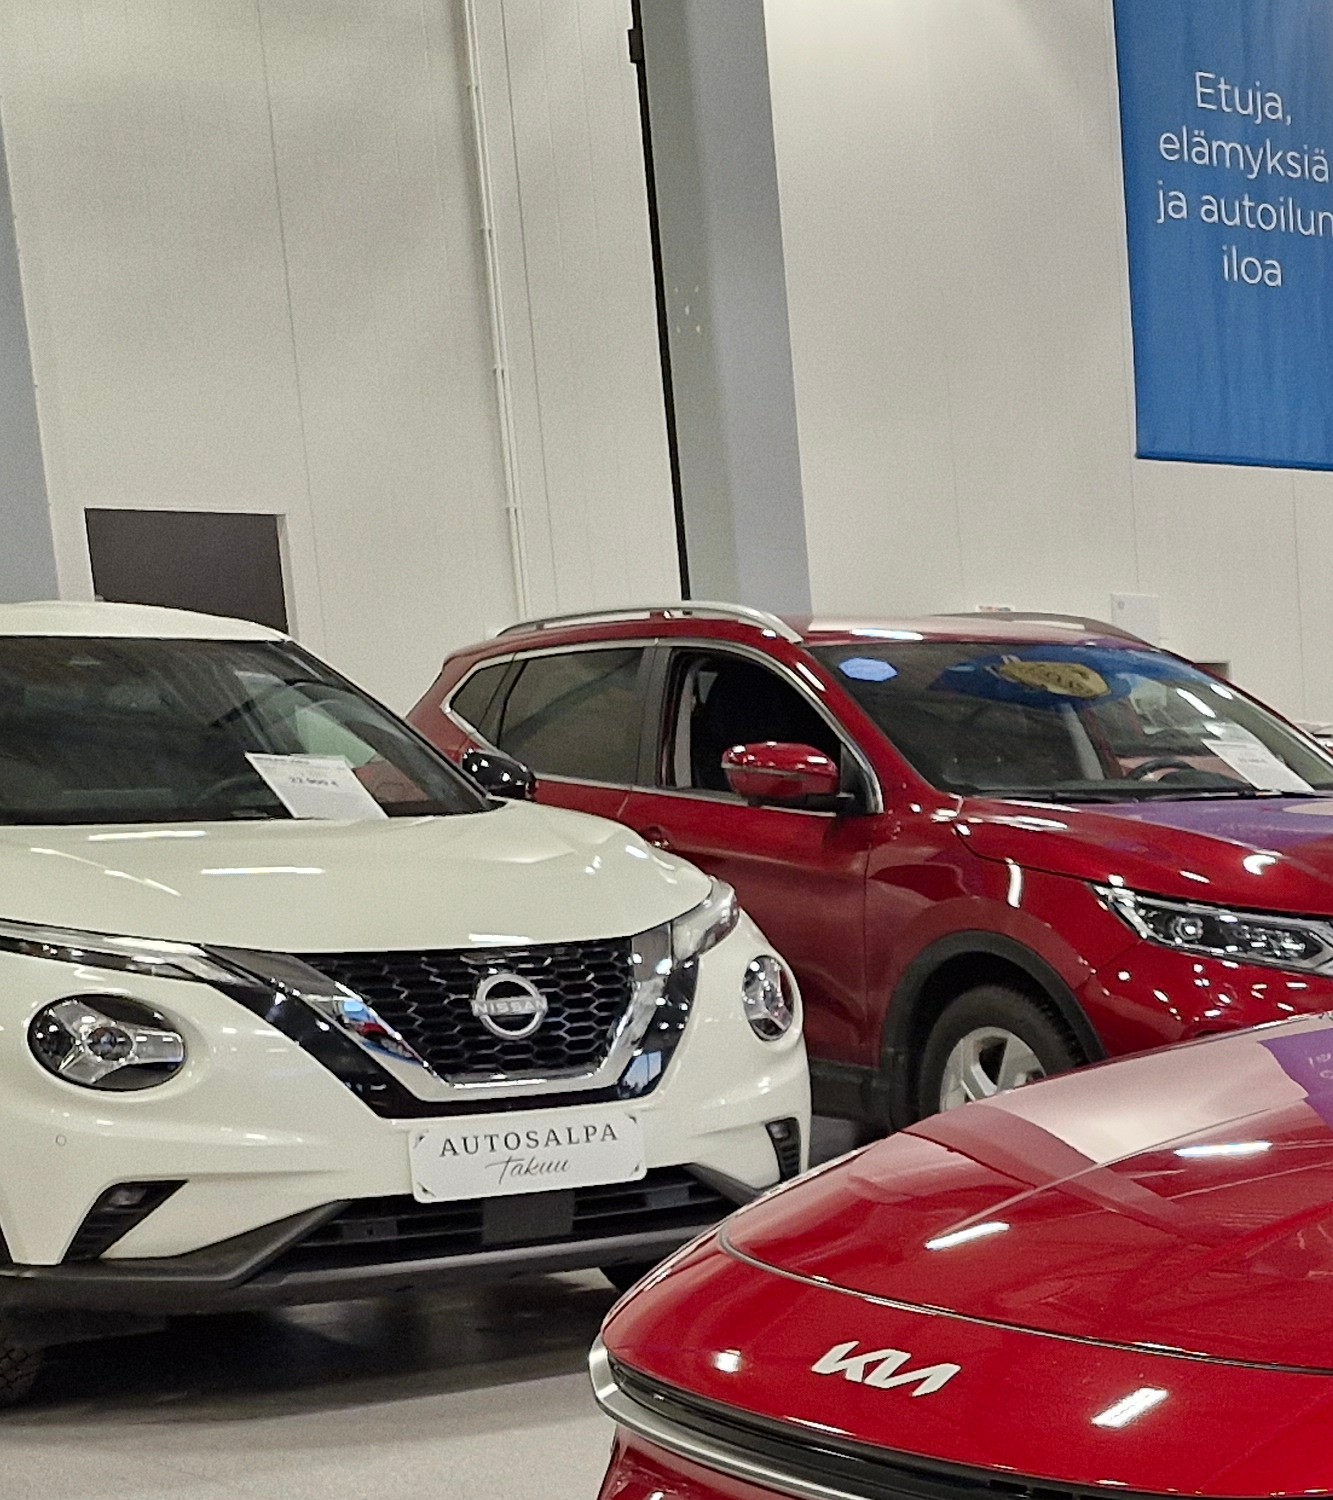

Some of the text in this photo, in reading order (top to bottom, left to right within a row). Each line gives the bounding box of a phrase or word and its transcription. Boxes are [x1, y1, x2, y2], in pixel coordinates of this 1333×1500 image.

[1194, 71, 1292, 126] Etuja,
[1159, 124, 1330, 183] elämyksiä
[1156, 180, 1188, 224] ja
[1222, 244, 1283, 288] iloa
[474, 998, 547, 1016] NISSAN
[439, 1122, 619, 1158] AUTOSALPA
[484, 1155, 570, 1186] Takuu
[810, 1340, 962, 1397] KIA
